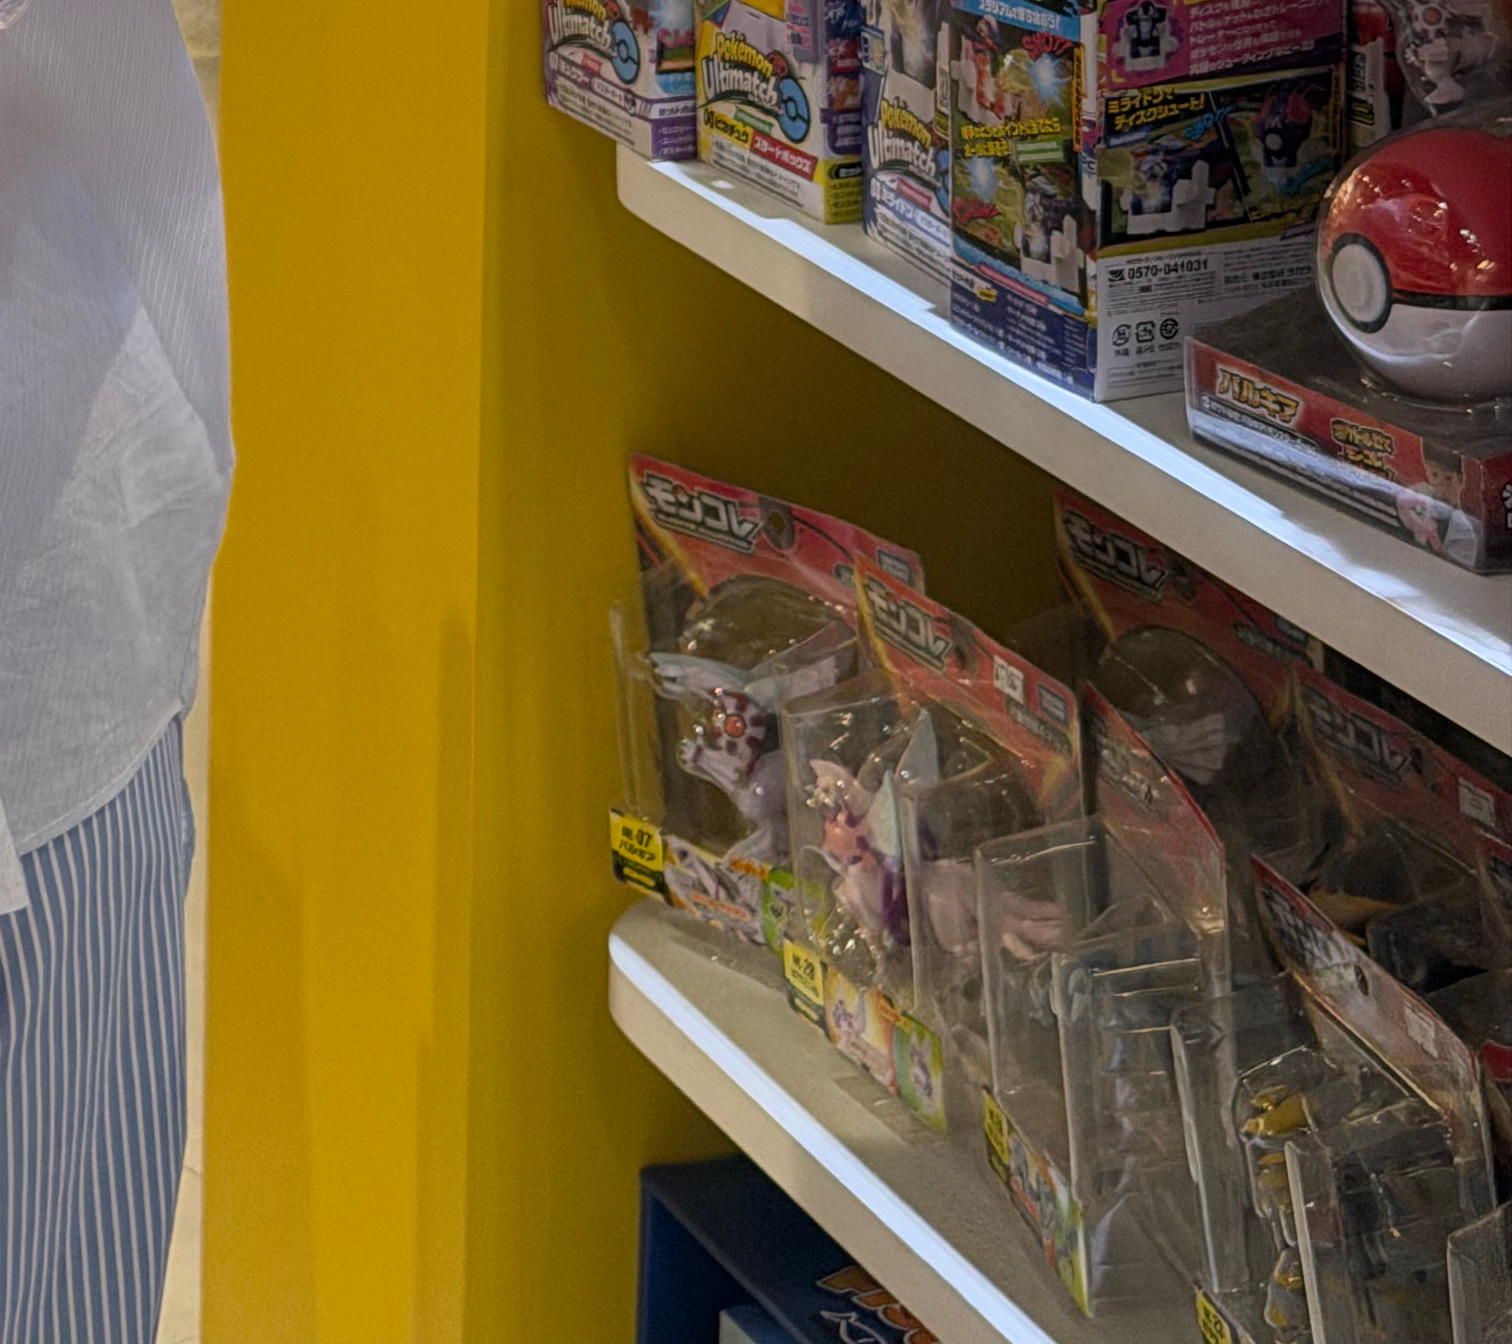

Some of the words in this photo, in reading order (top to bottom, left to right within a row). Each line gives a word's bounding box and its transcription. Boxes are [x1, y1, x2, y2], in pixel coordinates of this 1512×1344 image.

[701, 55, 779, 107] Ultimatch
[715, 30, 774, 80] Pokémon
[643, 472, 763, 541] モンコレ
[865, 578, 953, 659] モンコレ
